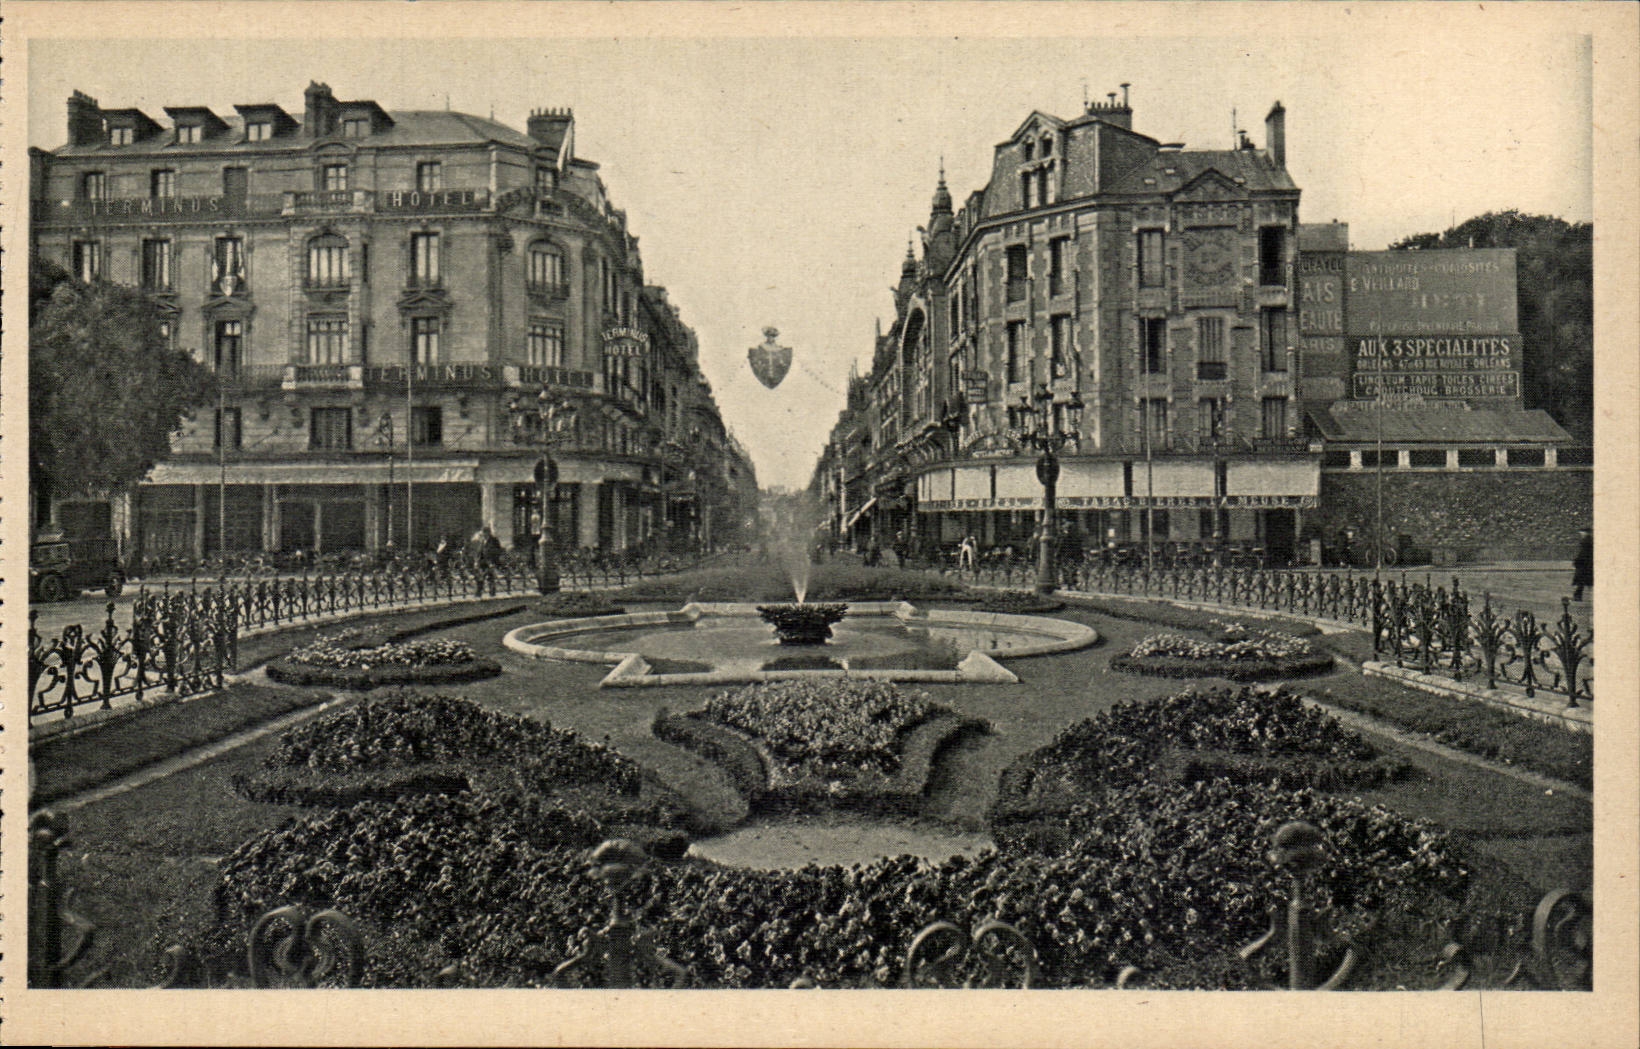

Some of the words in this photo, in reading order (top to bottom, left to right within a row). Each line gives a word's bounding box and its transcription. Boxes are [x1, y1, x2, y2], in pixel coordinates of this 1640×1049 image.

[91, 197, 218, 216] TERMINUS
[392, 191, 468, 207] HOTEL
[601, 326, 649, 343] TERMINUS
[604, 343, 642, 356] HOTEL
[1357, 339, 1388, 357] AUX
[1392, 339, 1403, 357] 3
[367, 365, 492, 383] TERMINUS
[522, 367, 588, 385] HOTEL
[1410, 375, 1437, 385] TAPIS
[1442, 375, 1474, 385] TOILES
[1365, 386, 1438, 396] CAOUTCHOUC
[1445, 385, 1506, 395] BROSSERIE
